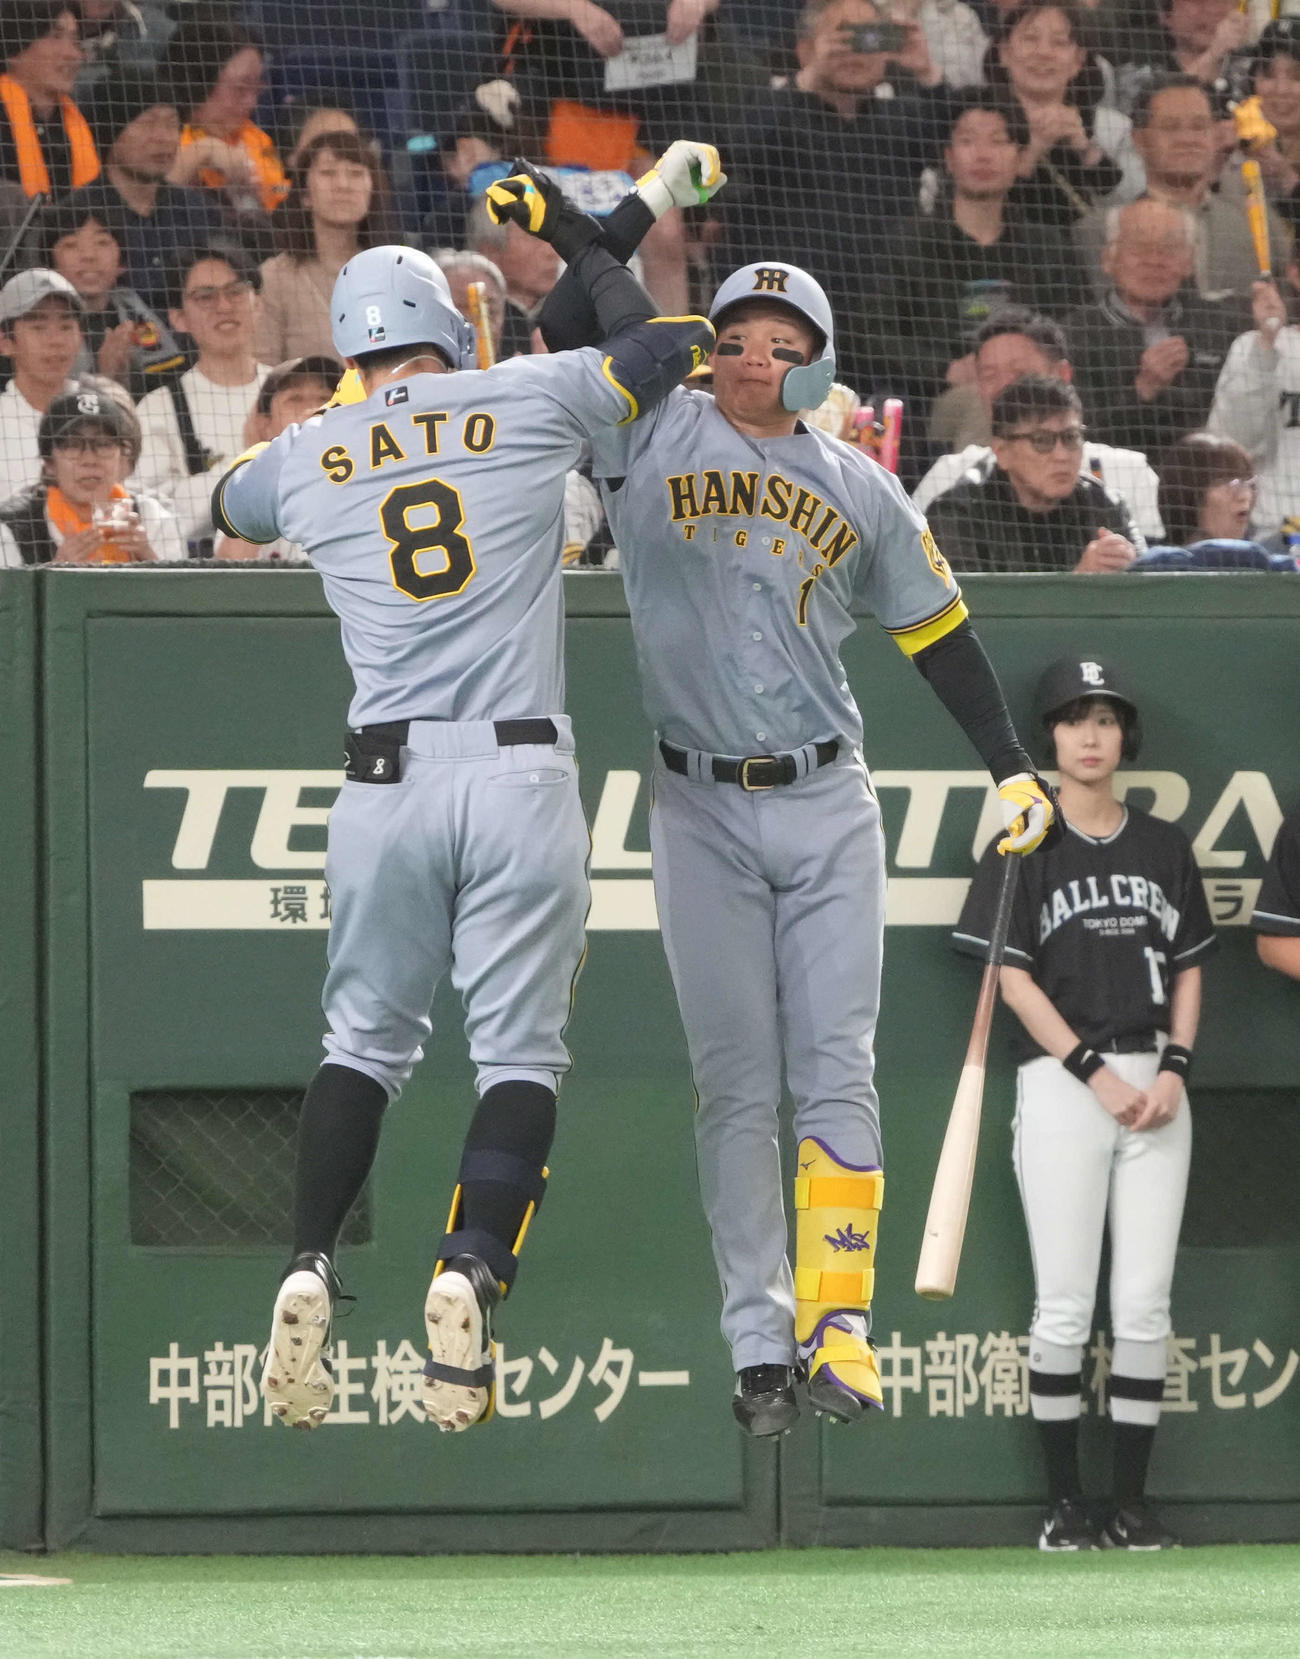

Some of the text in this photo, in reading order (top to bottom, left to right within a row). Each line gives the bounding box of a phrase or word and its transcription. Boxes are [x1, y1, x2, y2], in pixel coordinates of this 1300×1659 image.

[365, 305, 382, 326] 8
[320, 411, 497, 485] SATO
[378, 477, 478, 603] 8
[667, 469, 859, 568] HANSHIN
[684, 524, 824, 578] TIGES
[797, 576, 816, 627] 1
[373, 758, 385, 775] 8
[1039, 874, 1181, 946] BALL CREW
[1213, 884, 1243, 921] ラ
[149, 1337, 690, 1430] 中部生検センター
